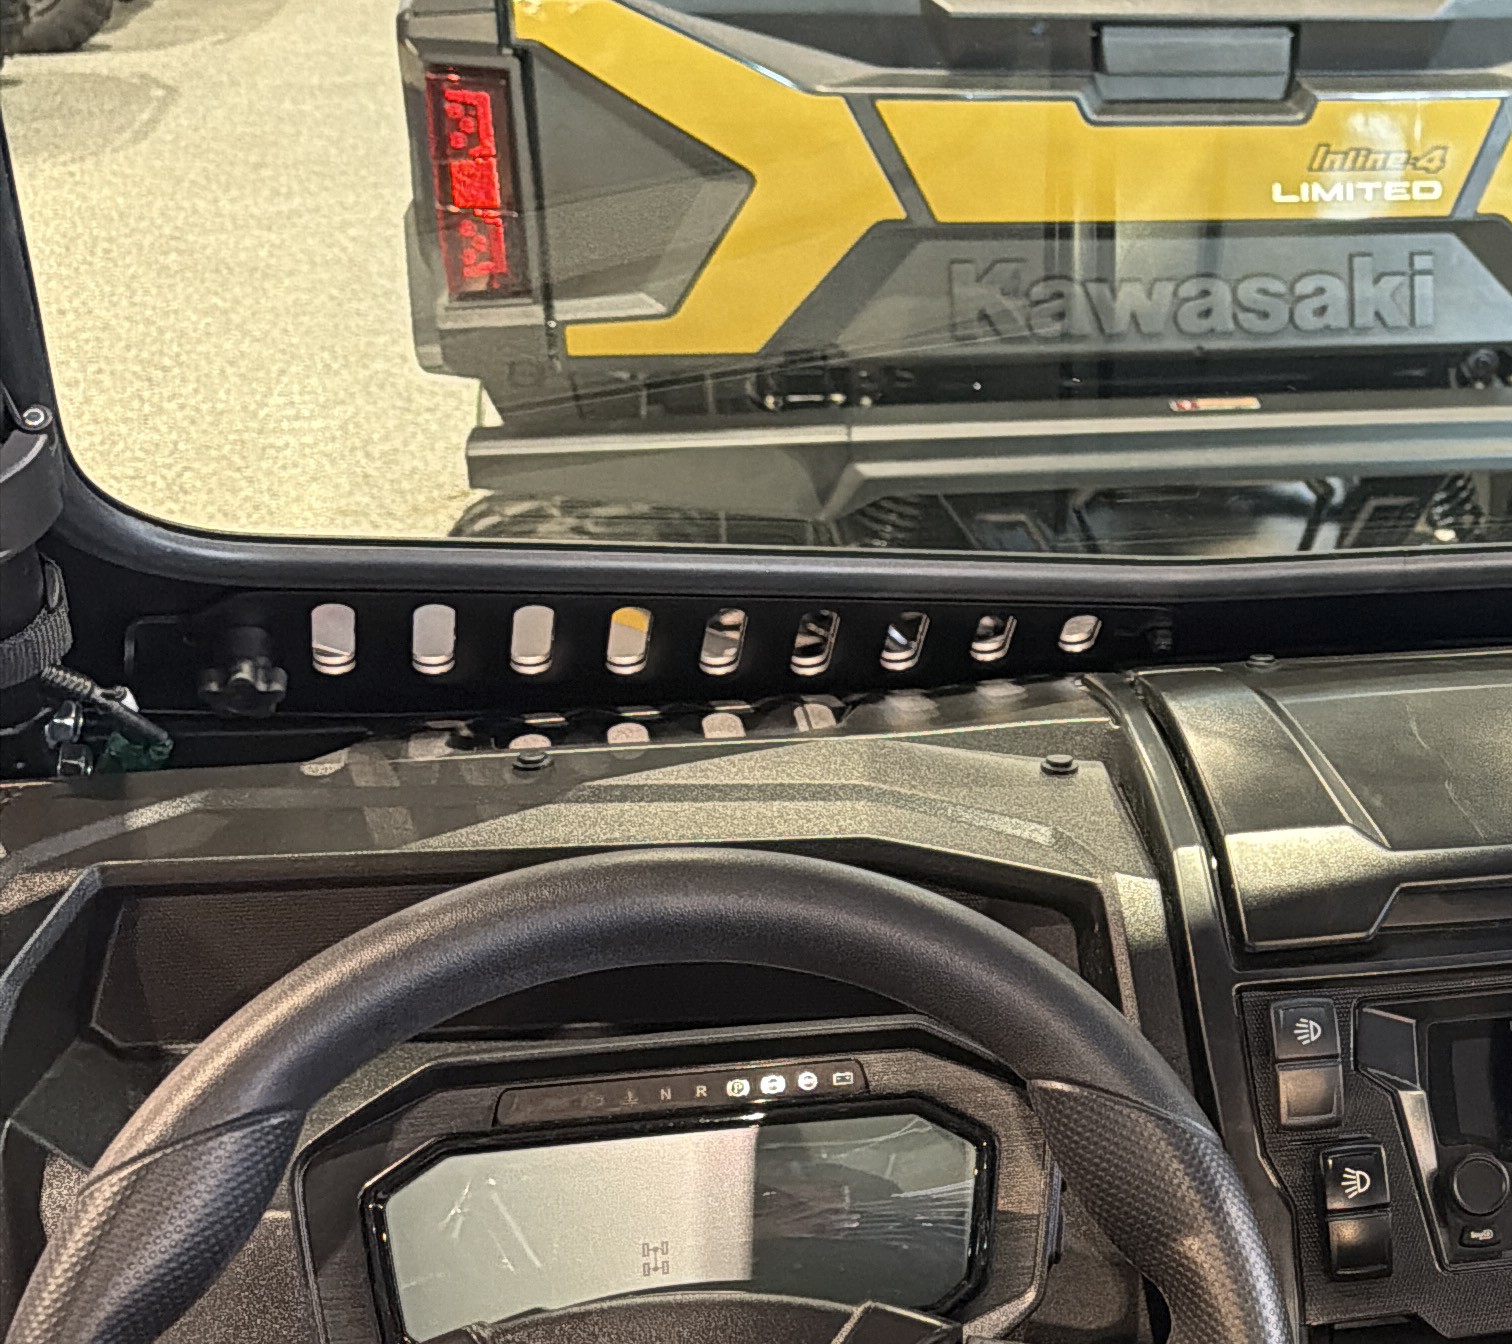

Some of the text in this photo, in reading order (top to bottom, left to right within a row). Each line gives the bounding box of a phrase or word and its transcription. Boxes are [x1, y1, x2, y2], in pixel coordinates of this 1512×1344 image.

[1271, 179, 1443, 203] LIMITED
[949, 251, 1435, 340] Kawasaki
[659, 1088, 672, 1101] N
[696, 1085, 707, 1097] R
